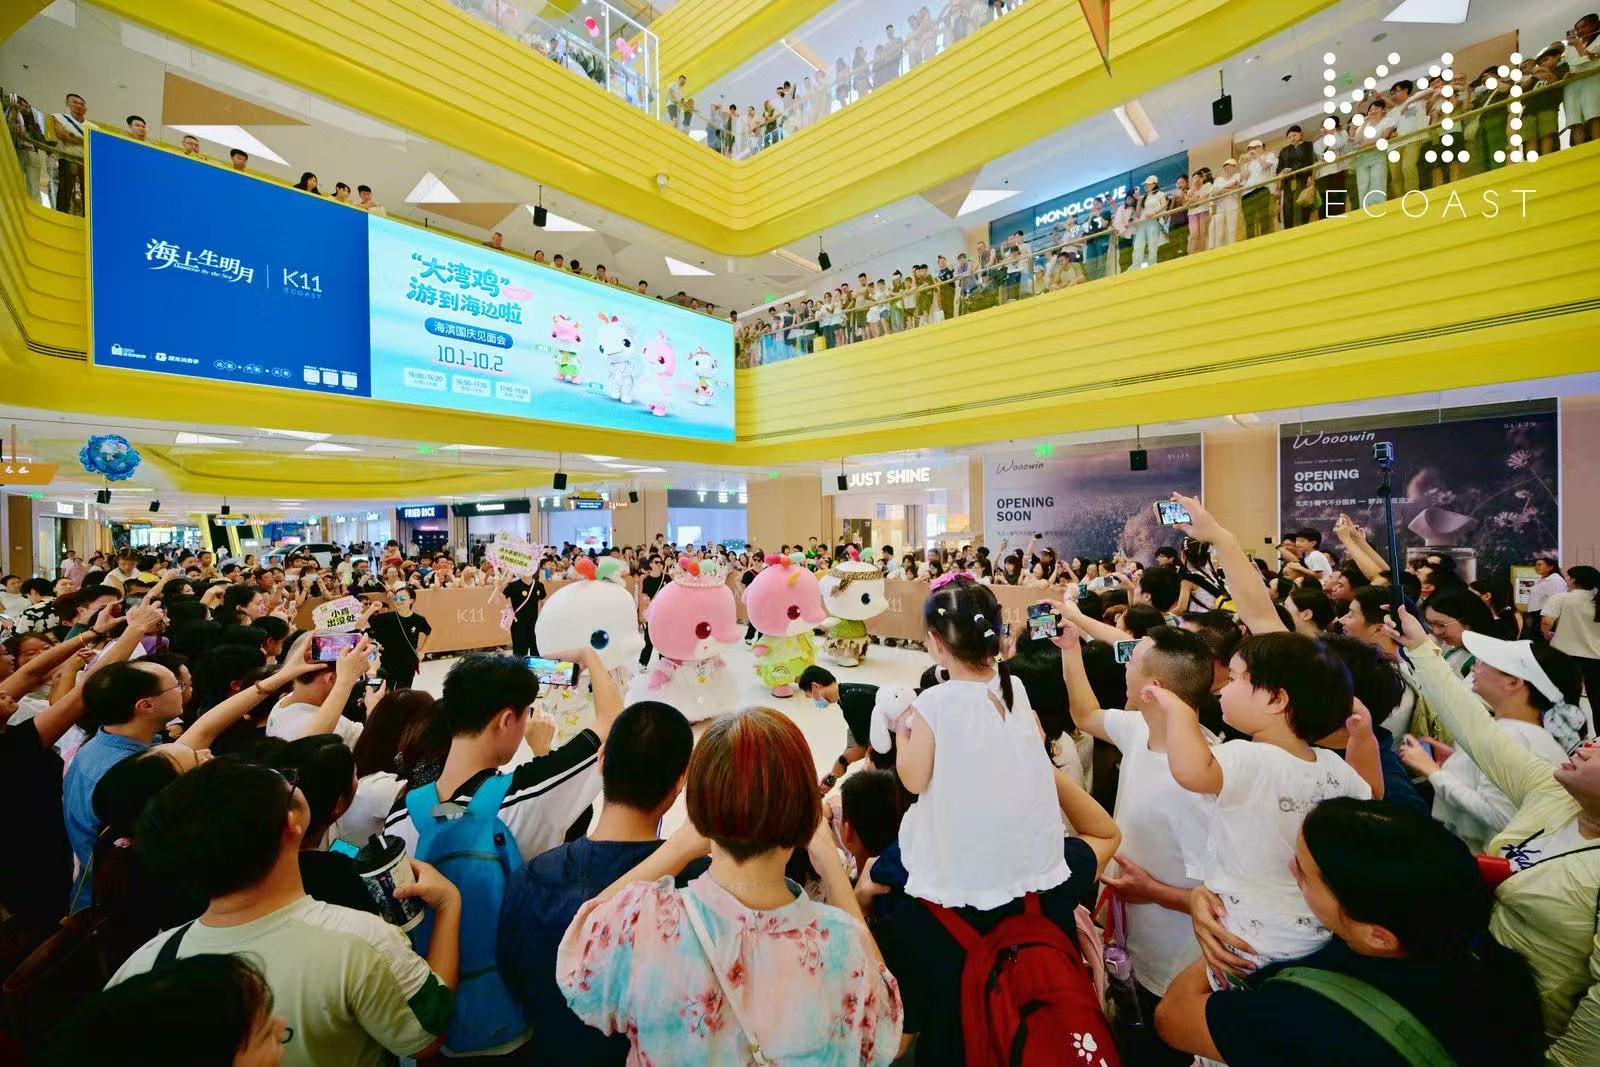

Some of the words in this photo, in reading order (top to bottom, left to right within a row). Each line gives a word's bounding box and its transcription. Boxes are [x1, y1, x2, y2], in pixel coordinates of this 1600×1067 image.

[145, 238, 255, 284] 海上生明月
[283, 267, 322, 292] K11
[406, 276, 522, 325] 游到海边啦
[437, 344, 503, 372] 10.1-10.2
[849, 471, 882, 488] JUST
[886, 467, 931, 485] SHINE
[1294, 469, 1360, 482] OPENING
[1294, 481, 1334, 493] SOON
[996, 496, 1055, 510] OPENING
[996, 510, 1032, 522] SOON
[331, 607, 350, 618] 小鸡
[457, 608, 485, 624] K11
[327, 614, 357, 628] 出没处
